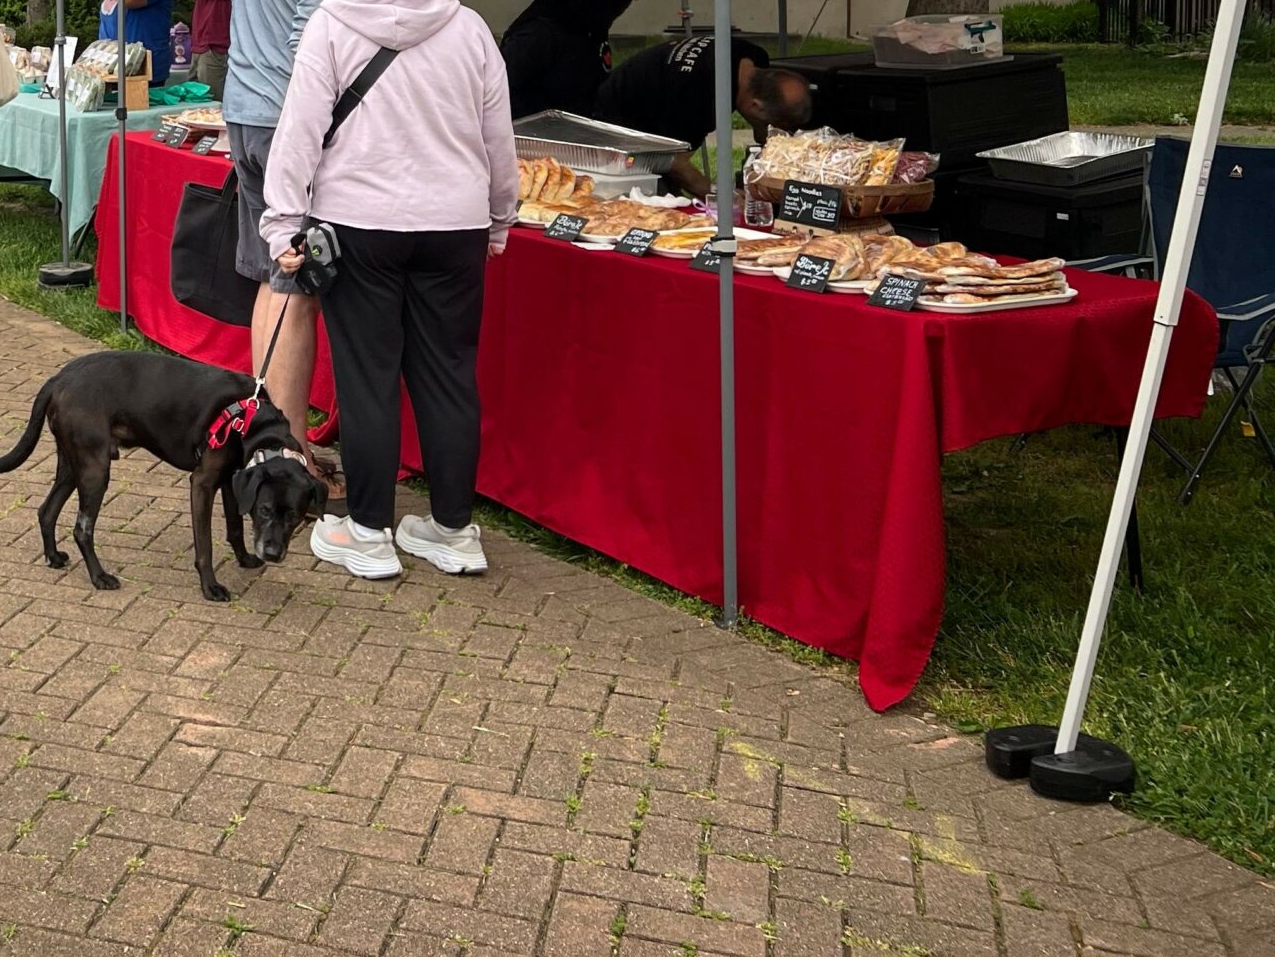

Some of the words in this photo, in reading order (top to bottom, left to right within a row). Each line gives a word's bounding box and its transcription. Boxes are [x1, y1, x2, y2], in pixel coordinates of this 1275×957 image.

[681, 47, 702, 72] CAFE
[886, 277, 919, 289] SPINACH
[880, 287, 913, 296] CHEESE
